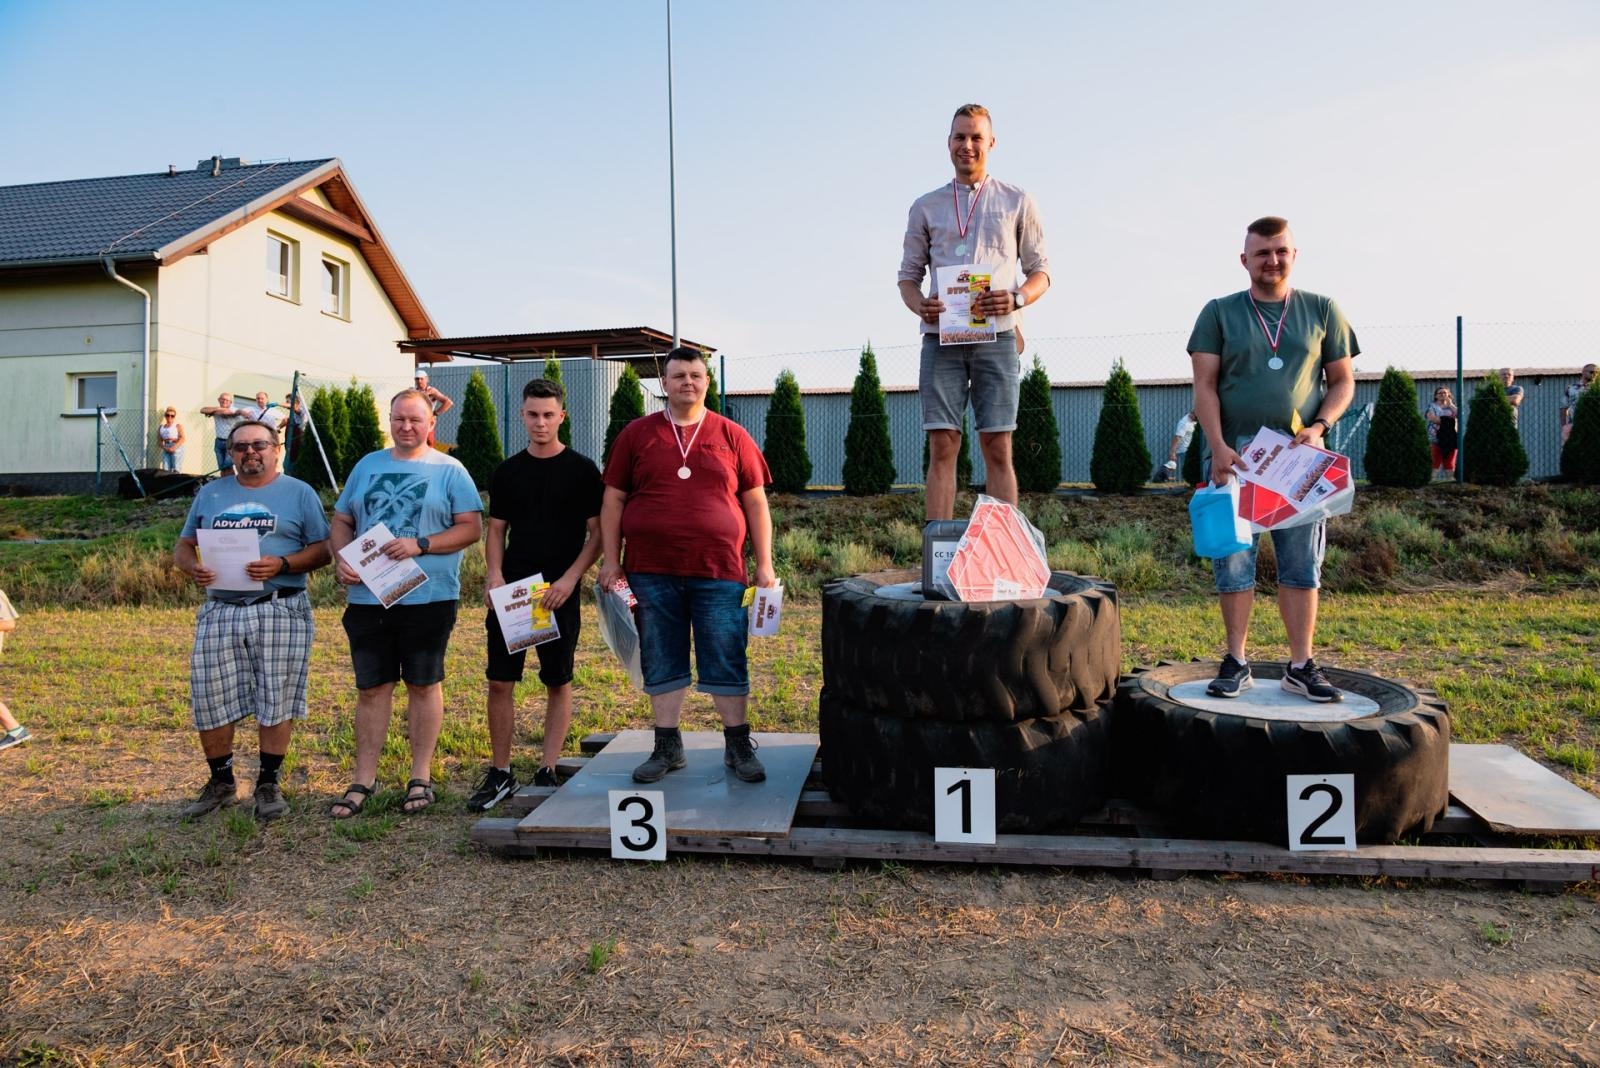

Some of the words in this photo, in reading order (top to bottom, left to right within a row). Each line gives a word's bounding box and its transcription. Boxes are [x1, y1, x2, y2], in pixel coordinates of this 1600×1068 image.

[214, 518, 274, 528] ADVENTURE
[618, 797, 658, 852] 3
[947, 780, 971, 833] 1
[1299, 784, 1346, 845] 2
